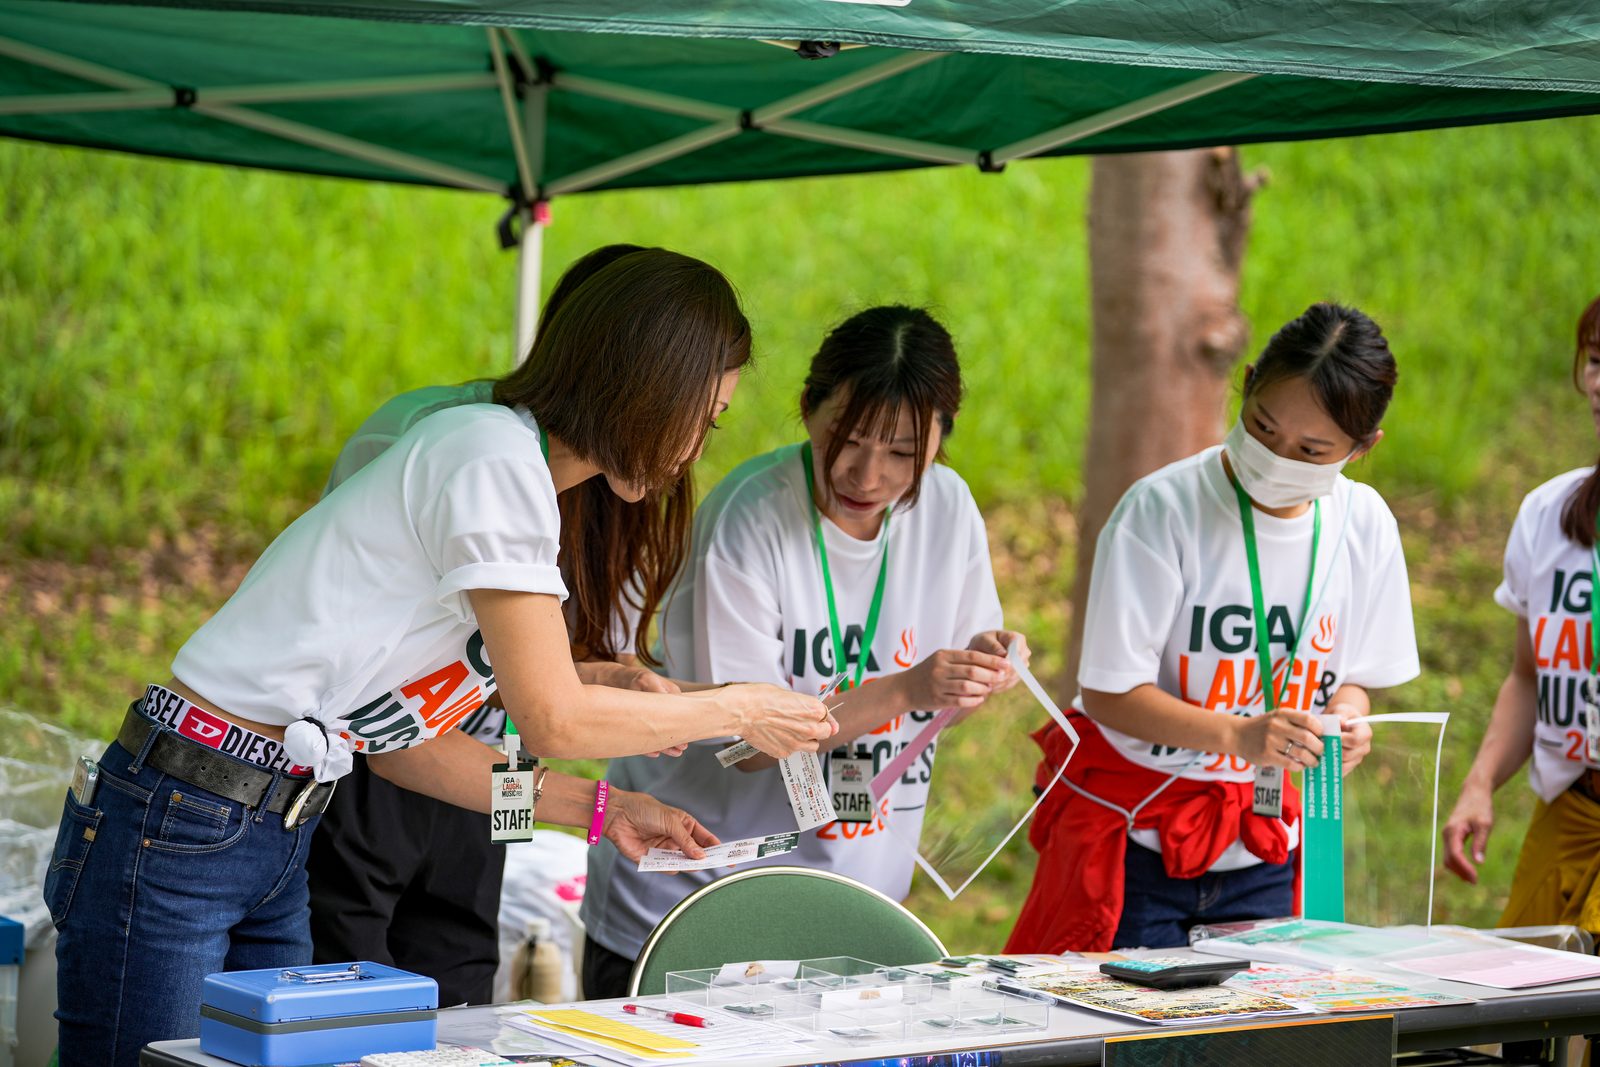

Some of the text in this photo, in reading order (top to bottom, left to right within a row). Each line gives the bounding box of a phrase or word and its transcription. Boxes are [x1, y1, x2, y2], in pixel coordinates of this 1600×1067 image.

[1189, 605, 1298, 653] IGA
[793, 625, 880, 677] IGA
[1314, 671, 1337, 706] &
[833, 792, 870, 812] STAFF
[1255, 785, 1280, 807] STAFF
[493, 809, 531, 831] STAFF
[797, 806, 805, 818] IGA
